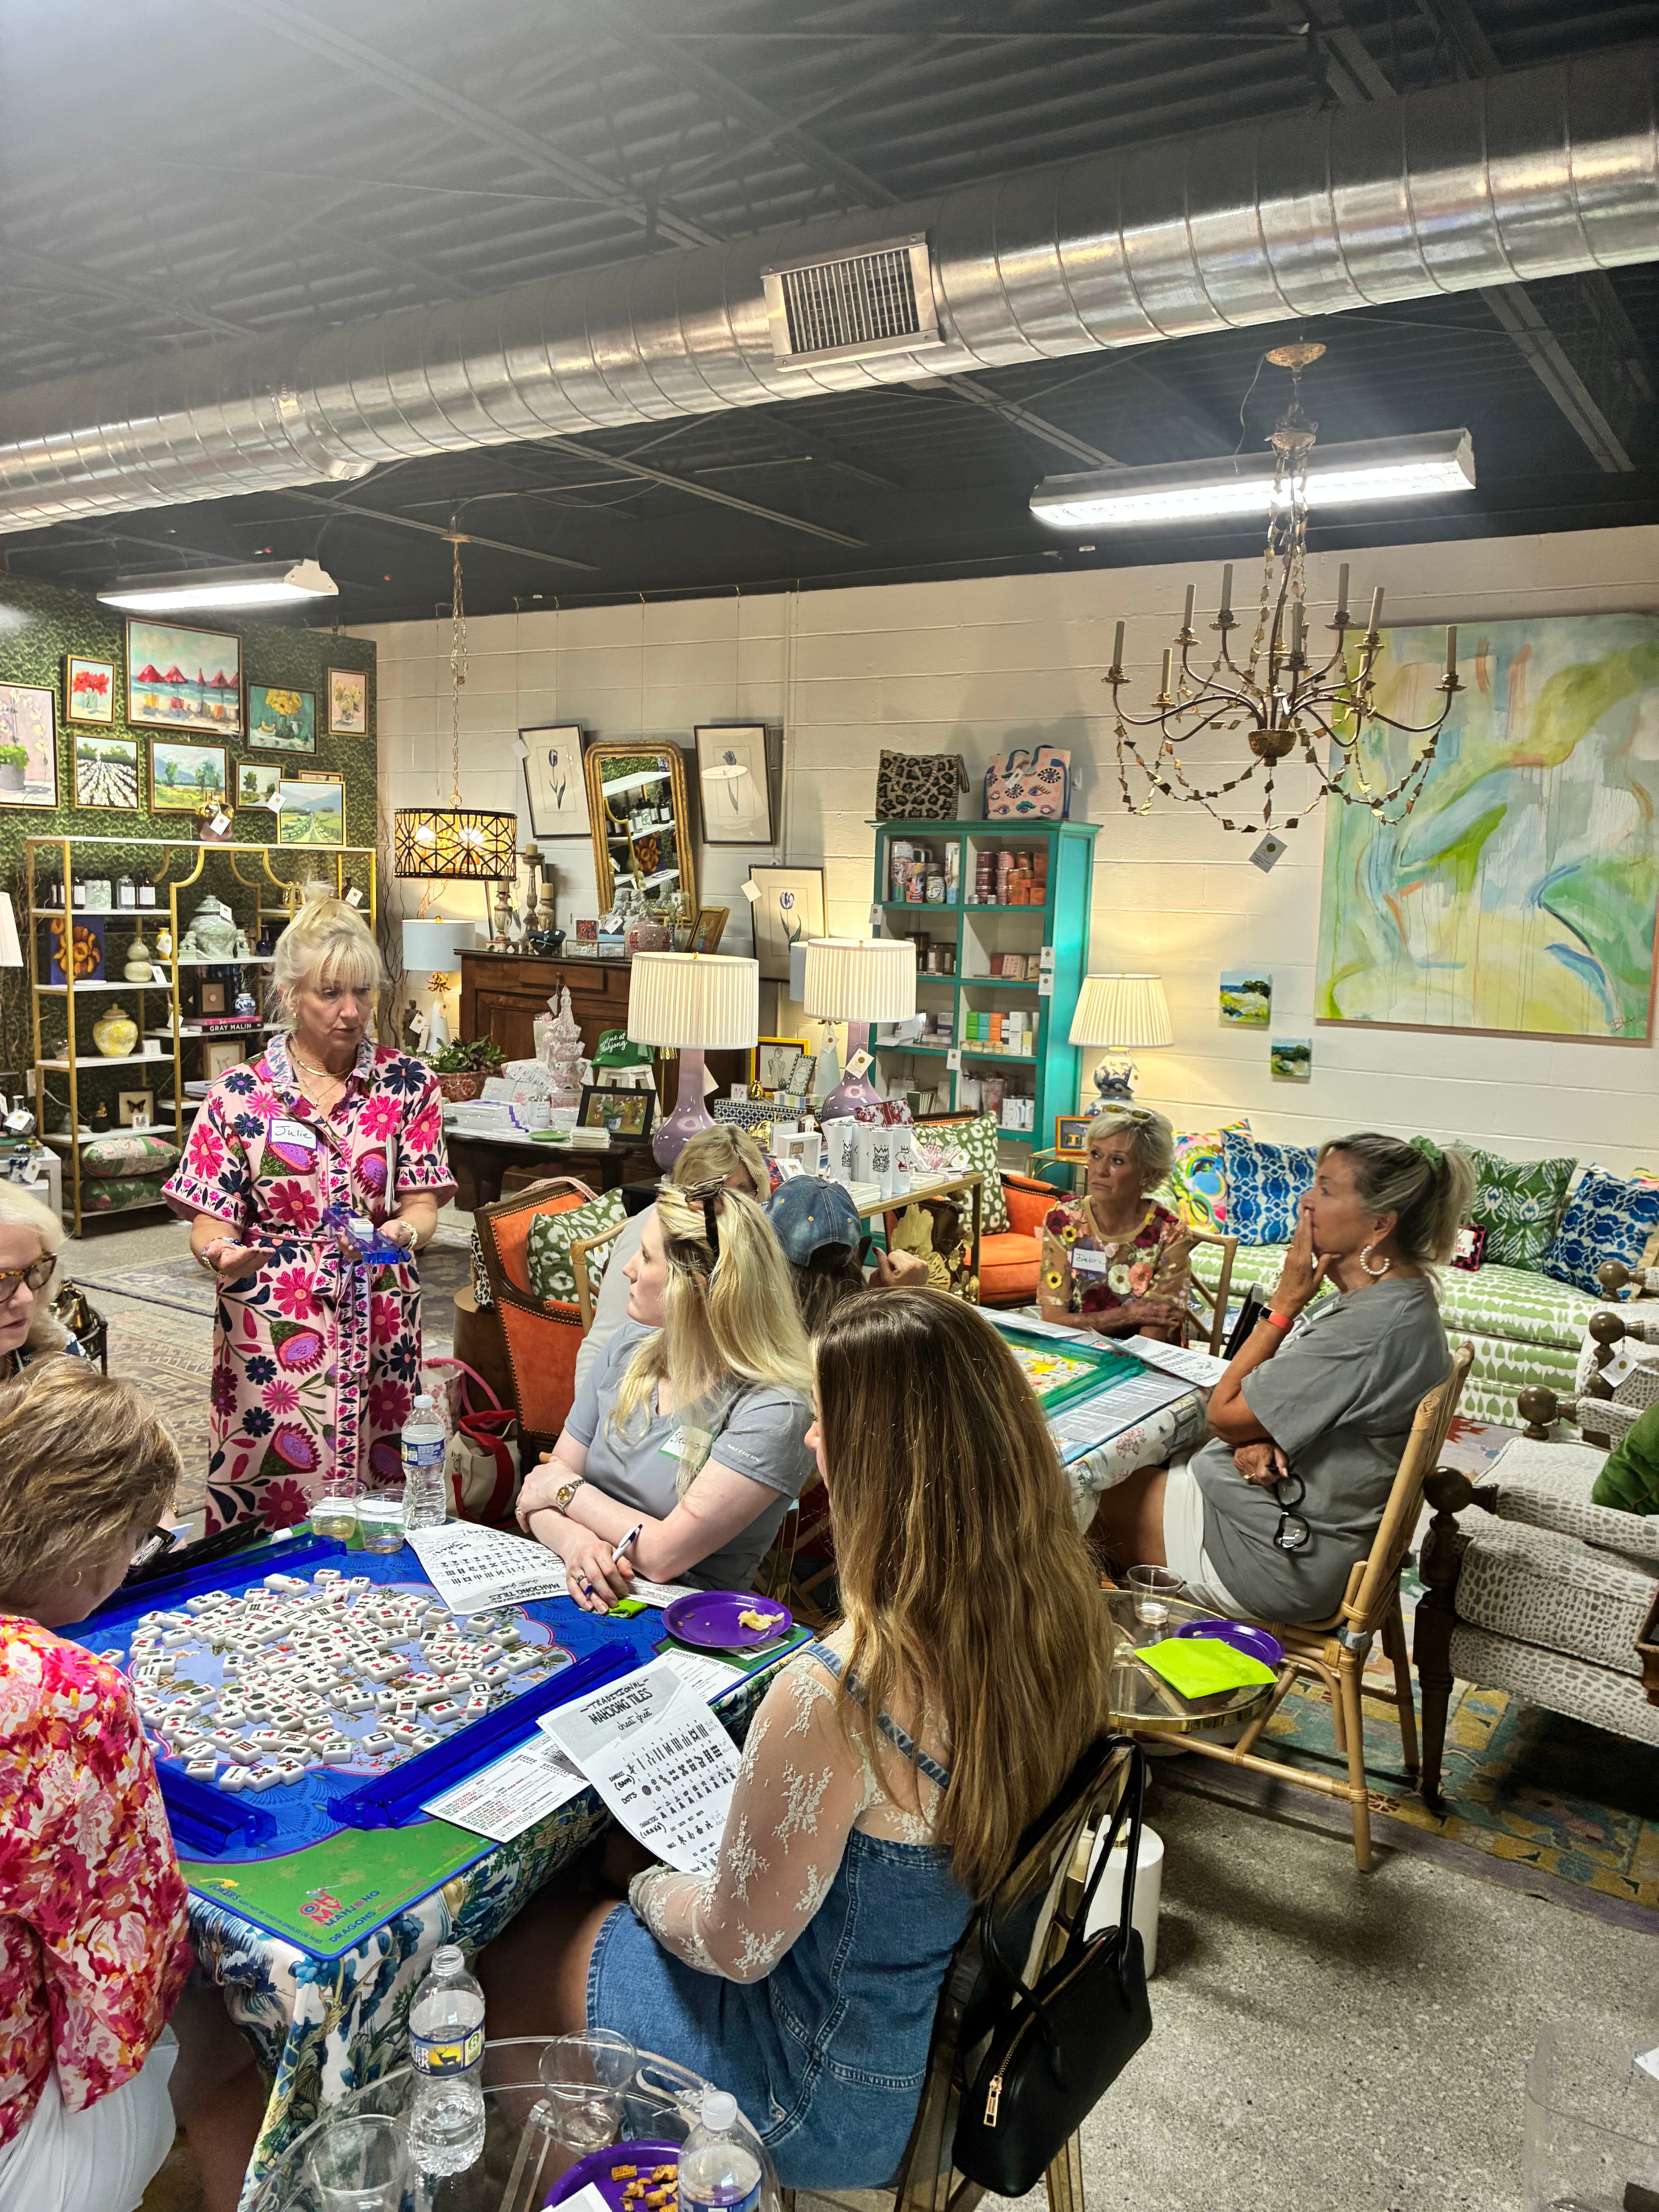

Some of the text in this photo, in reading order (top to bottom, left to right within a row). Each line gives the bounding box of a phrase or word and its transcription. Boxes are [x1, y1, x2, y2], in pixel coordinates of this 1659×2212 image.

[600, 1039, 628, 1054] Mahjong
[275, 1125, 312, 1139] Julie
[489, 1583, 560, 1601] MAHJONG TILES
[586, 1681, 645, 1709] TRADITIONAL
[588, 1688, 653, 1725] MAHJONG TILES
[616, 1707, 652, 1730] cheat sheet
[621, 1792, 637, 1804] DOTS
[299, 1893, 335, 1916] OH
[311, 1900, 343, 1924] MY
[324, 1890, 380, 1927] MAHJONG
[328, 1911, 376, 1942] DRAGONS
